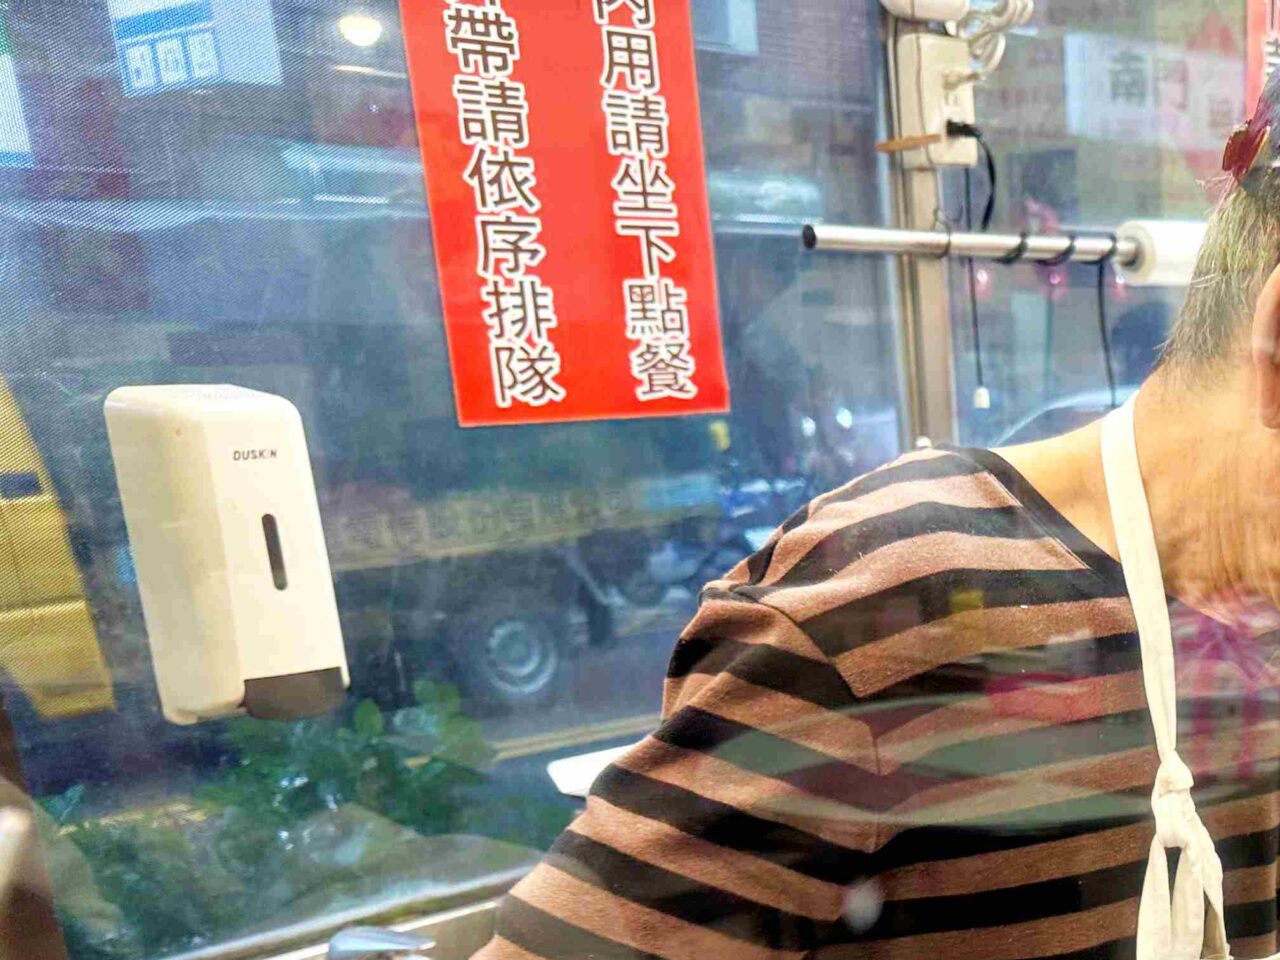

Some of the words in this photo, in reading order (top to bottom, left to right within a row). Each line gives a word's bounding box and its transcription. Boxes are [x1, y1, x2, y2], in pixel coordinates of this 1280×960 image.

[447, 0, 566, 406] 帶請依序排隊
